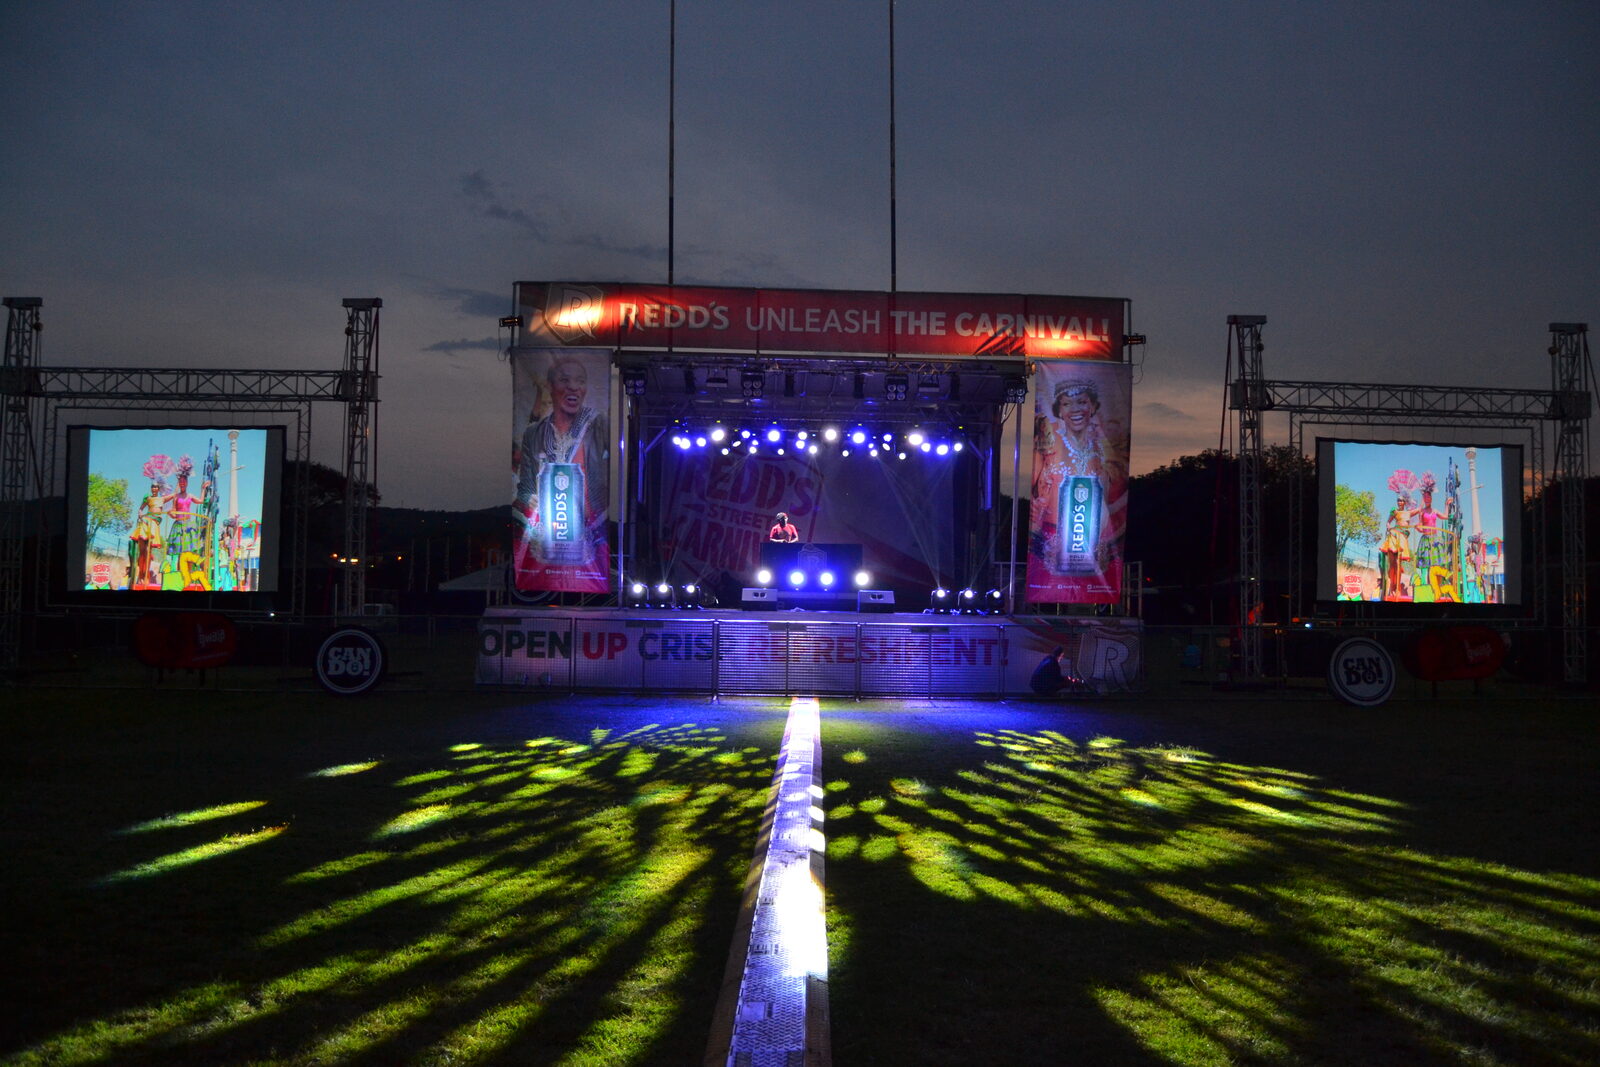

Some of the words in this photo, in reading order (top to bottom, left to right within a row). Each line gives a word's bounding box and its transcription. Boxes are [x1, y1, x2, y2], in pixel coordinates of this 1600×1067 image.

[618, 301, 730, 331] REDD'S
[745, 306, 881, 335] UNLEASH
[890, 311, 946, 336] THE
[954, 311, 1110, 343] CARNIVAL!
[679, 453, 814, 516] REDD'S
[553, 492, 568, 540] REDD'S
[1071, 504, 1087, 552] REDD'S
[327, 647, 372, 662] CAN
[481, 628, 572, 659] OPEN
[582, 631, 628, 660] UP
[747, 635, 1009, 665] REFRESHMENT!
[1343, 656, 1381, 671] CAN
[327, 660, 371, 676] DO!
